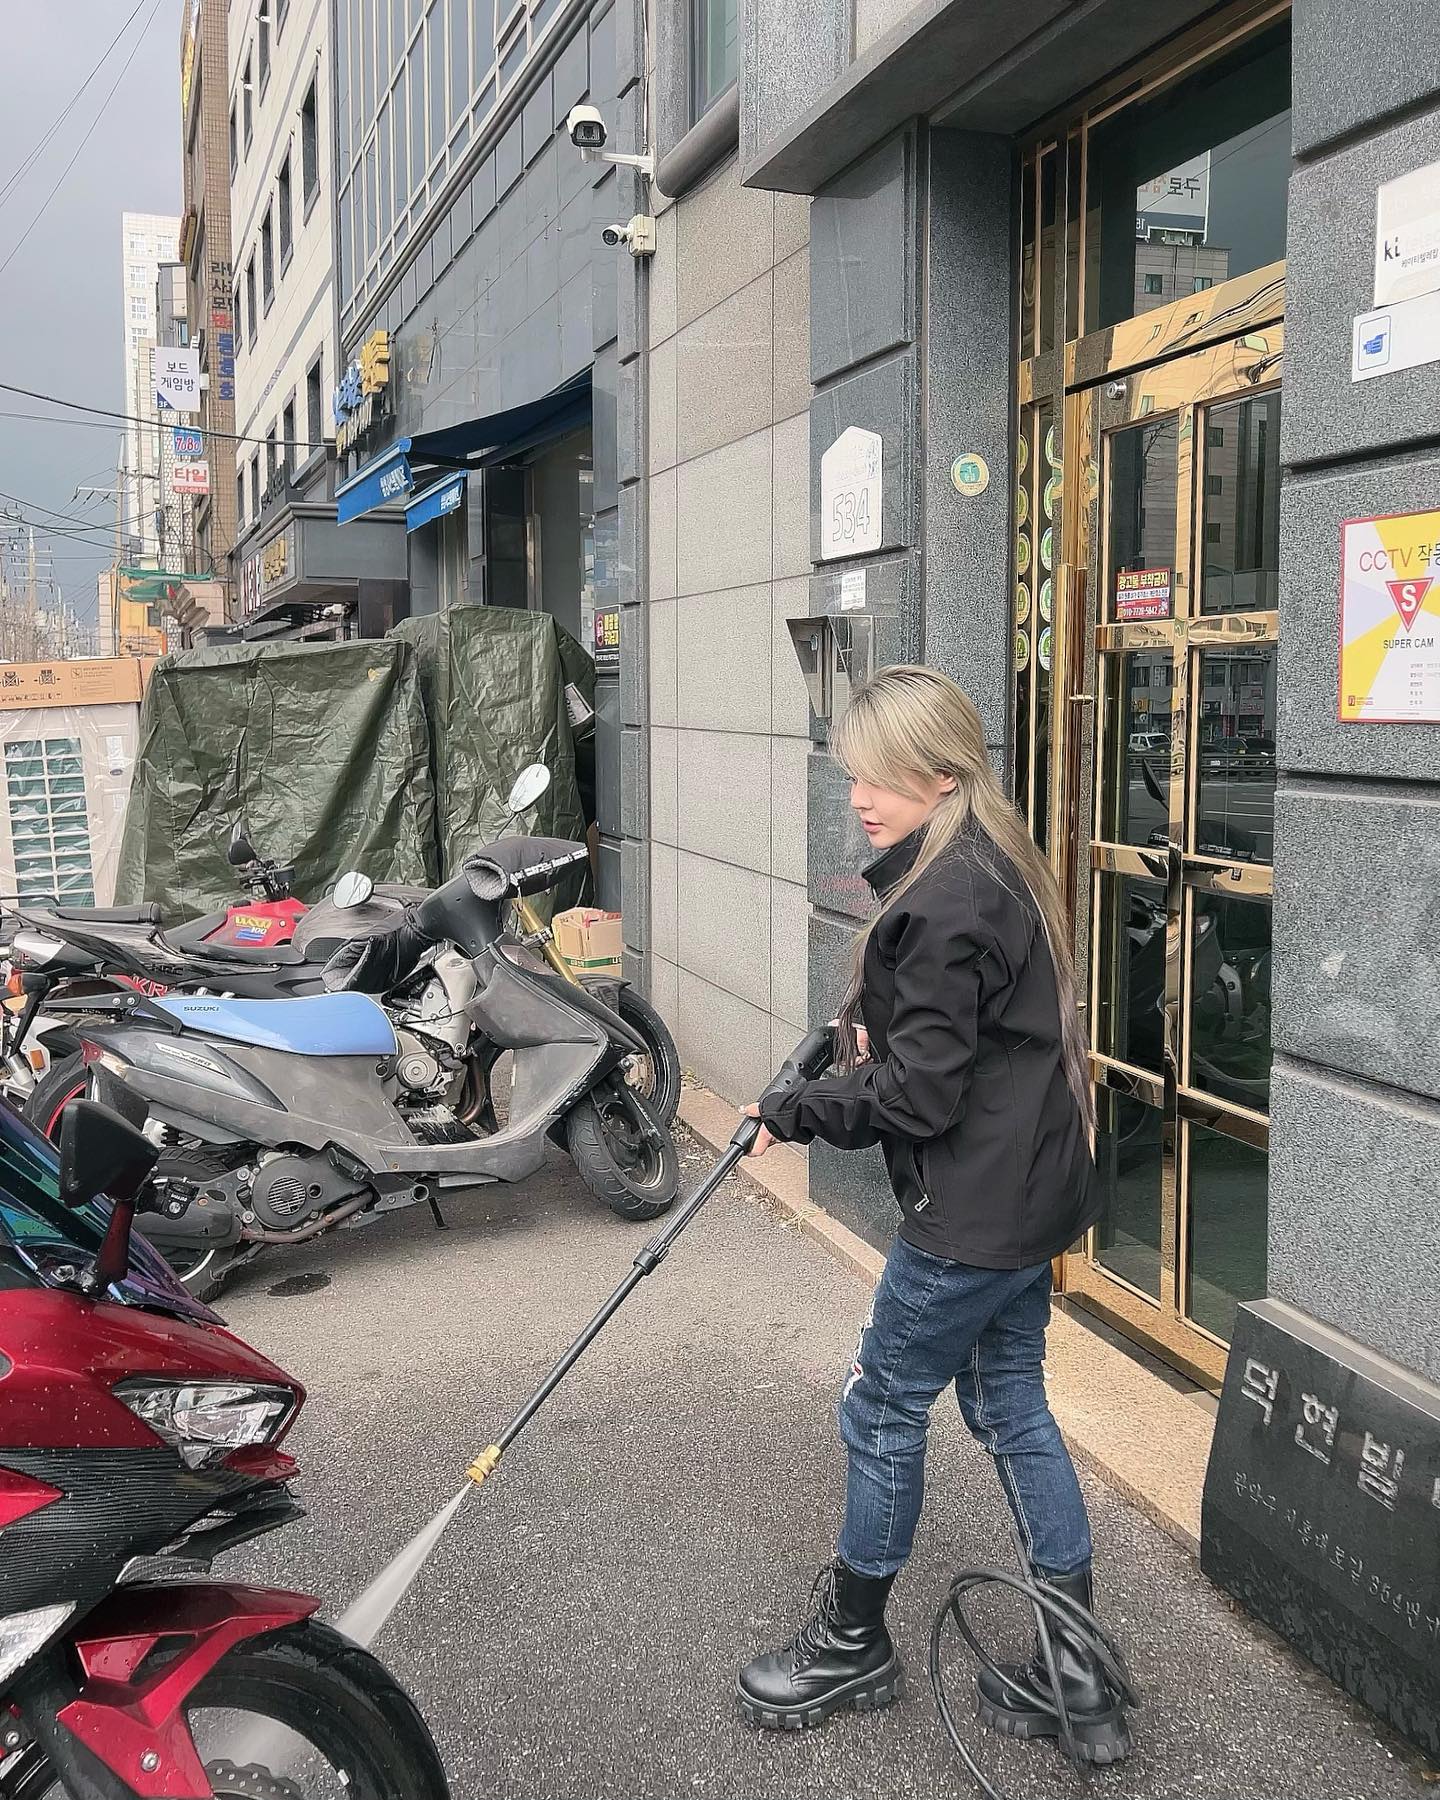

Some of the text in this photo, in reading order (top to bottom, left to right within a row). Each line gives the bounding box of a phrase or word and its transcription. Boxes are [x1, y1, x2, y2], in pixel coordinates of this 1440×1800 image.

[166, 361, 189, 373] 보드
[160, 377, 195, 392] 게임방
[158, 400, 169, 408] 3F
[175, 437, 200, 452] 7080
[174, 467, 207, 483] 타일
[832, 488, 871, 542] 534
[1359, 547, 1414, 572] CCTV
[1400, 584, 1418, 613] S
[1383, 638, 1434, 650] SUPER CAM
[1241, 1357, 1440, 1512] 덕현빌
